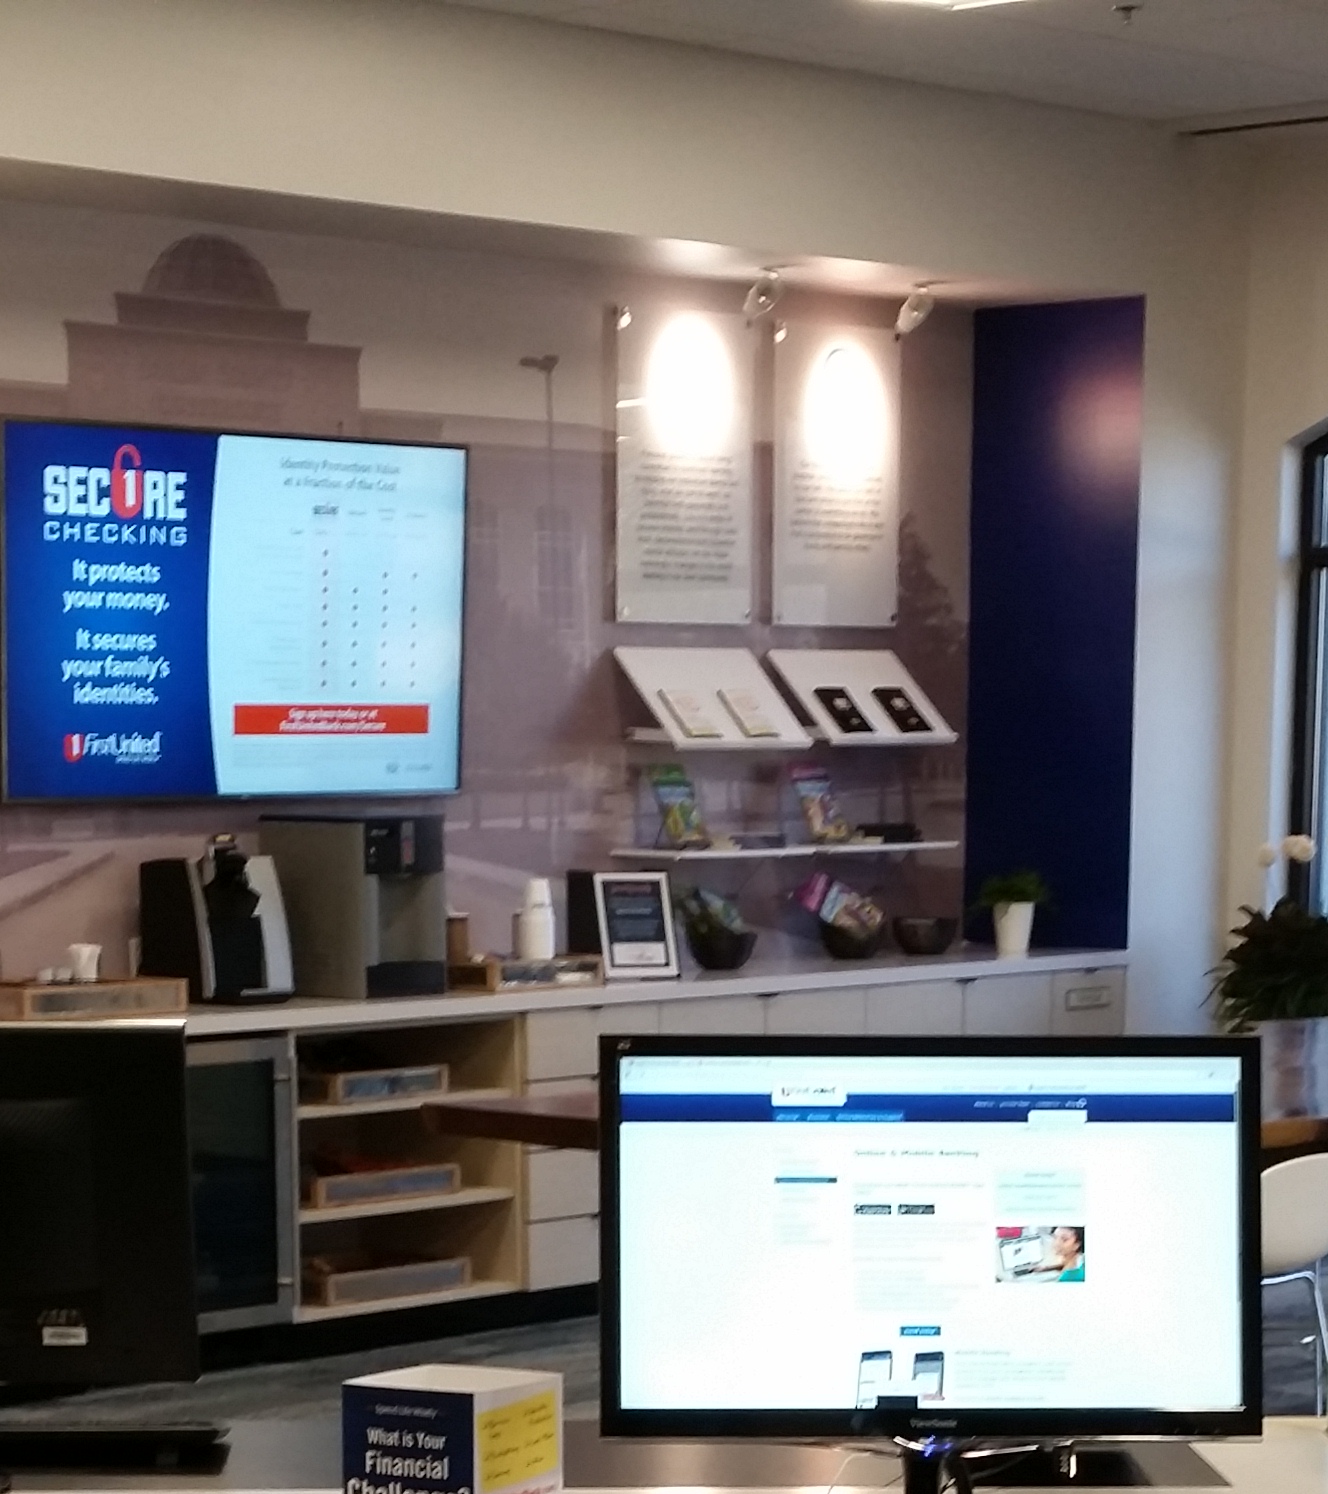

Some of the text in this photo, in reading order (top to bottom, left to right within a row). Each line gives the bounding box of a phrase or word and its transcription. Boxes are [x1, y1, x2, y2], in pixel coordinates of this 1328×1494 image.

[43, 521, 188, 547] CHECKING
[73, 559, 161, 587] It protects
[63, 591, 105, 614] your
[76, 628, 157, 651] It secures
[61, 659, 103, 682] your
[366, 1426, 447, 1451] What is Your
[365, 1450, 450, 1481] Financial
